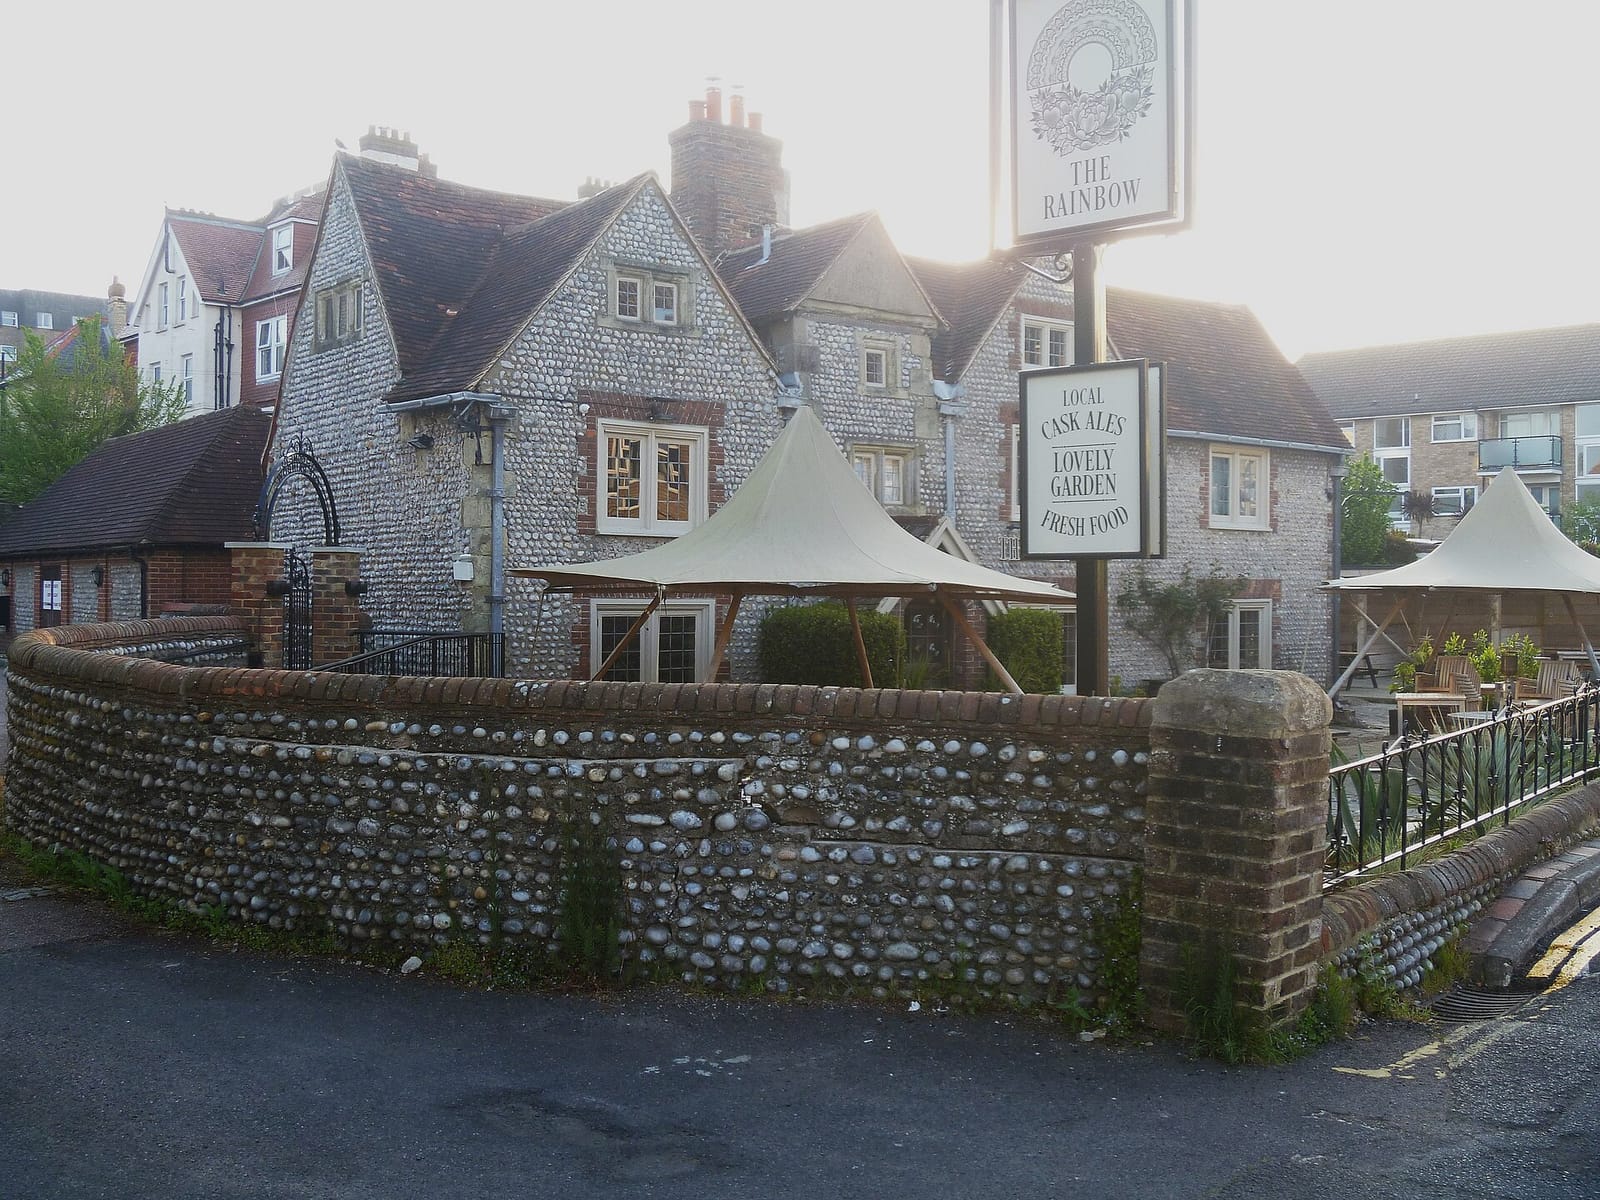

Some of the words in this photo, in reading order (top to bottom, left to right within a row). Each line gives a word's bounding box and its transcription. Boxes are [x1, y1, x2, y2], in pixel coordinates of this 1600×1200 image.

[1070, 155, 1111, 186] THE
[1043, 178, 1141, 220] RAINBOW
[1063, 387, 1105, 407] LOCAL
[1041, 411, 1081, 440] CASK
[1085, 410, 1127, 436] ALES
[1054, 448, 1115, 473] LOVELY
[1051, 473, 1117, 497] GARDEN
[1040, 509, 1085, 537] FRESH
[1090, 506, 1129, 536] FOOD
[998, 536, 1020, 561] TH
